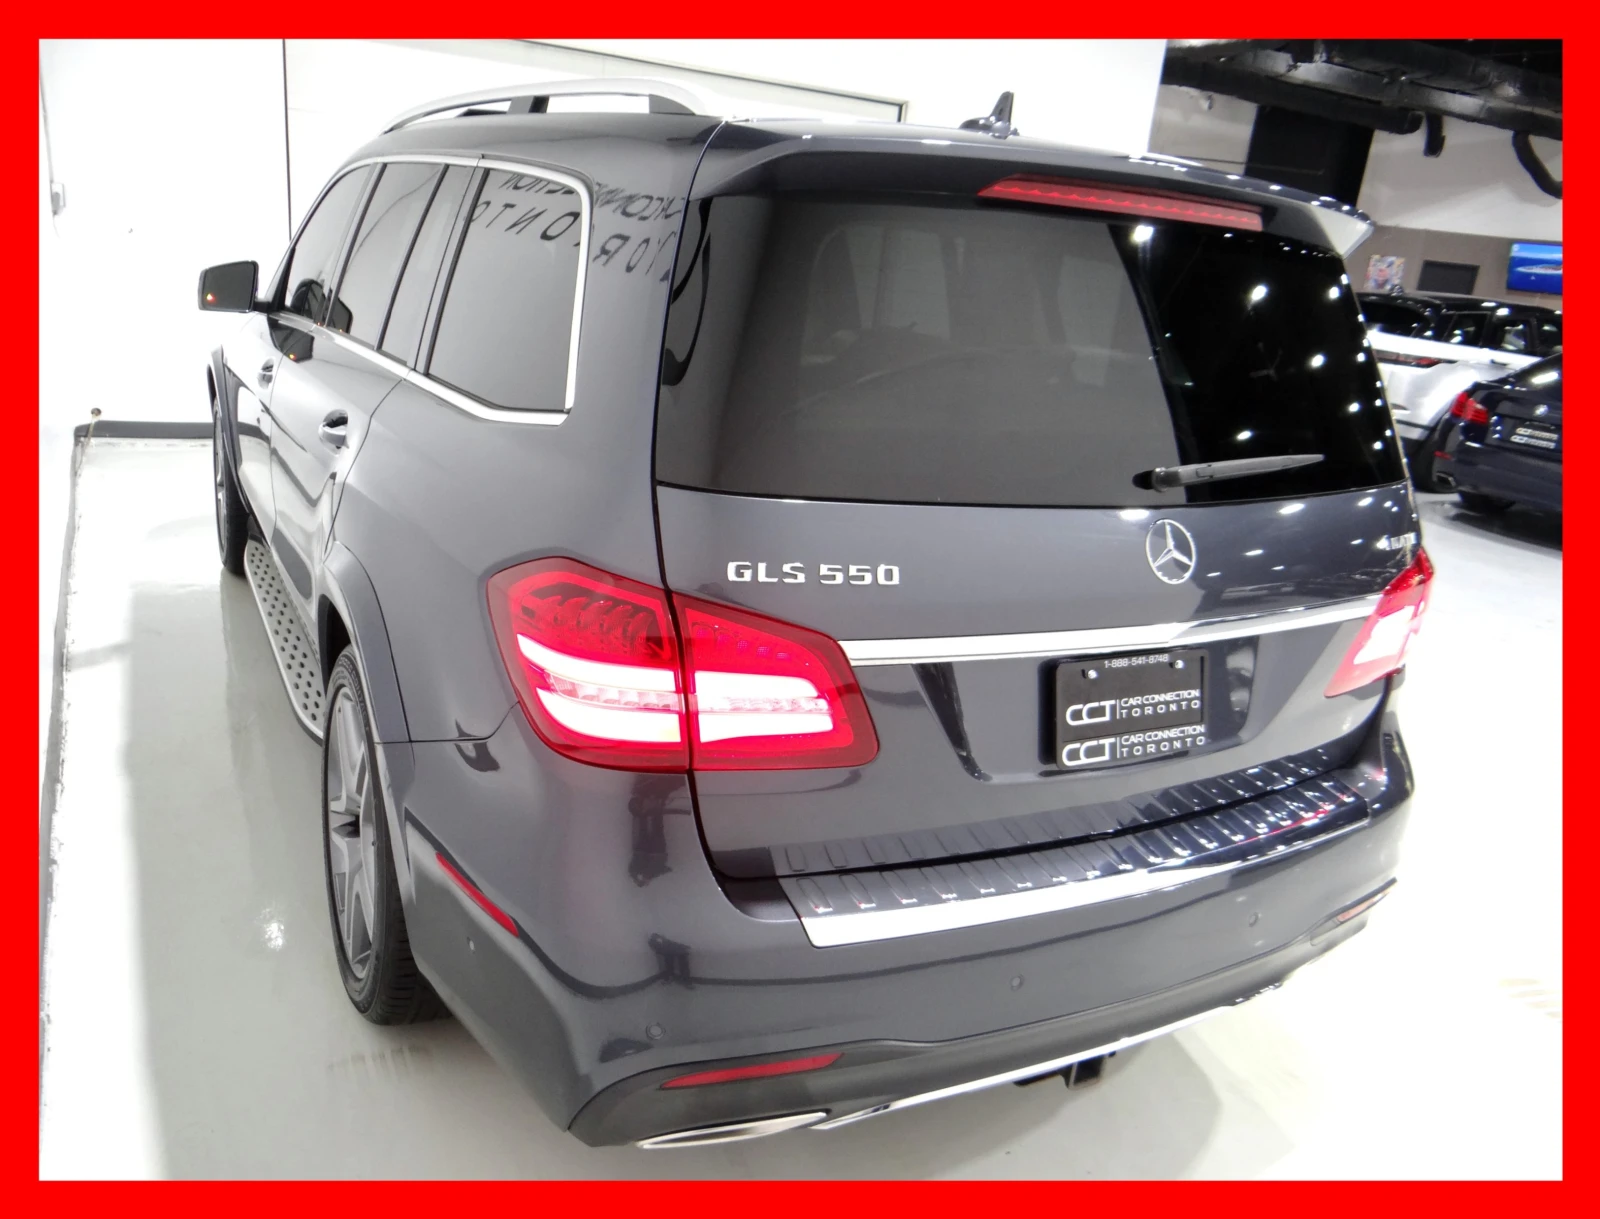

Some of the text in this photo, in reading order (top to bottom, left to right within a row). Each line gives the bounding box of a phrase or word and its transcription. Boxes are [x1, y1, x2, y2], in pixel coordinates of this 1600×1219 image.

[727, 561, 900, 585] GLS 550
[1103, 653, 1169, 669] 1-888-541-8748
[1120, 688, 1200, 707] CAR CONNECTION
[1065, 699, 1116, 726] CCT
[1120, 700, 1201, 718] TORONTO
[1121, 724, 1205, 746] CAR CONNECTION
[1061, 737, 1116, 767] CCT
[1121, 736, 1206, 758] TORONTO
